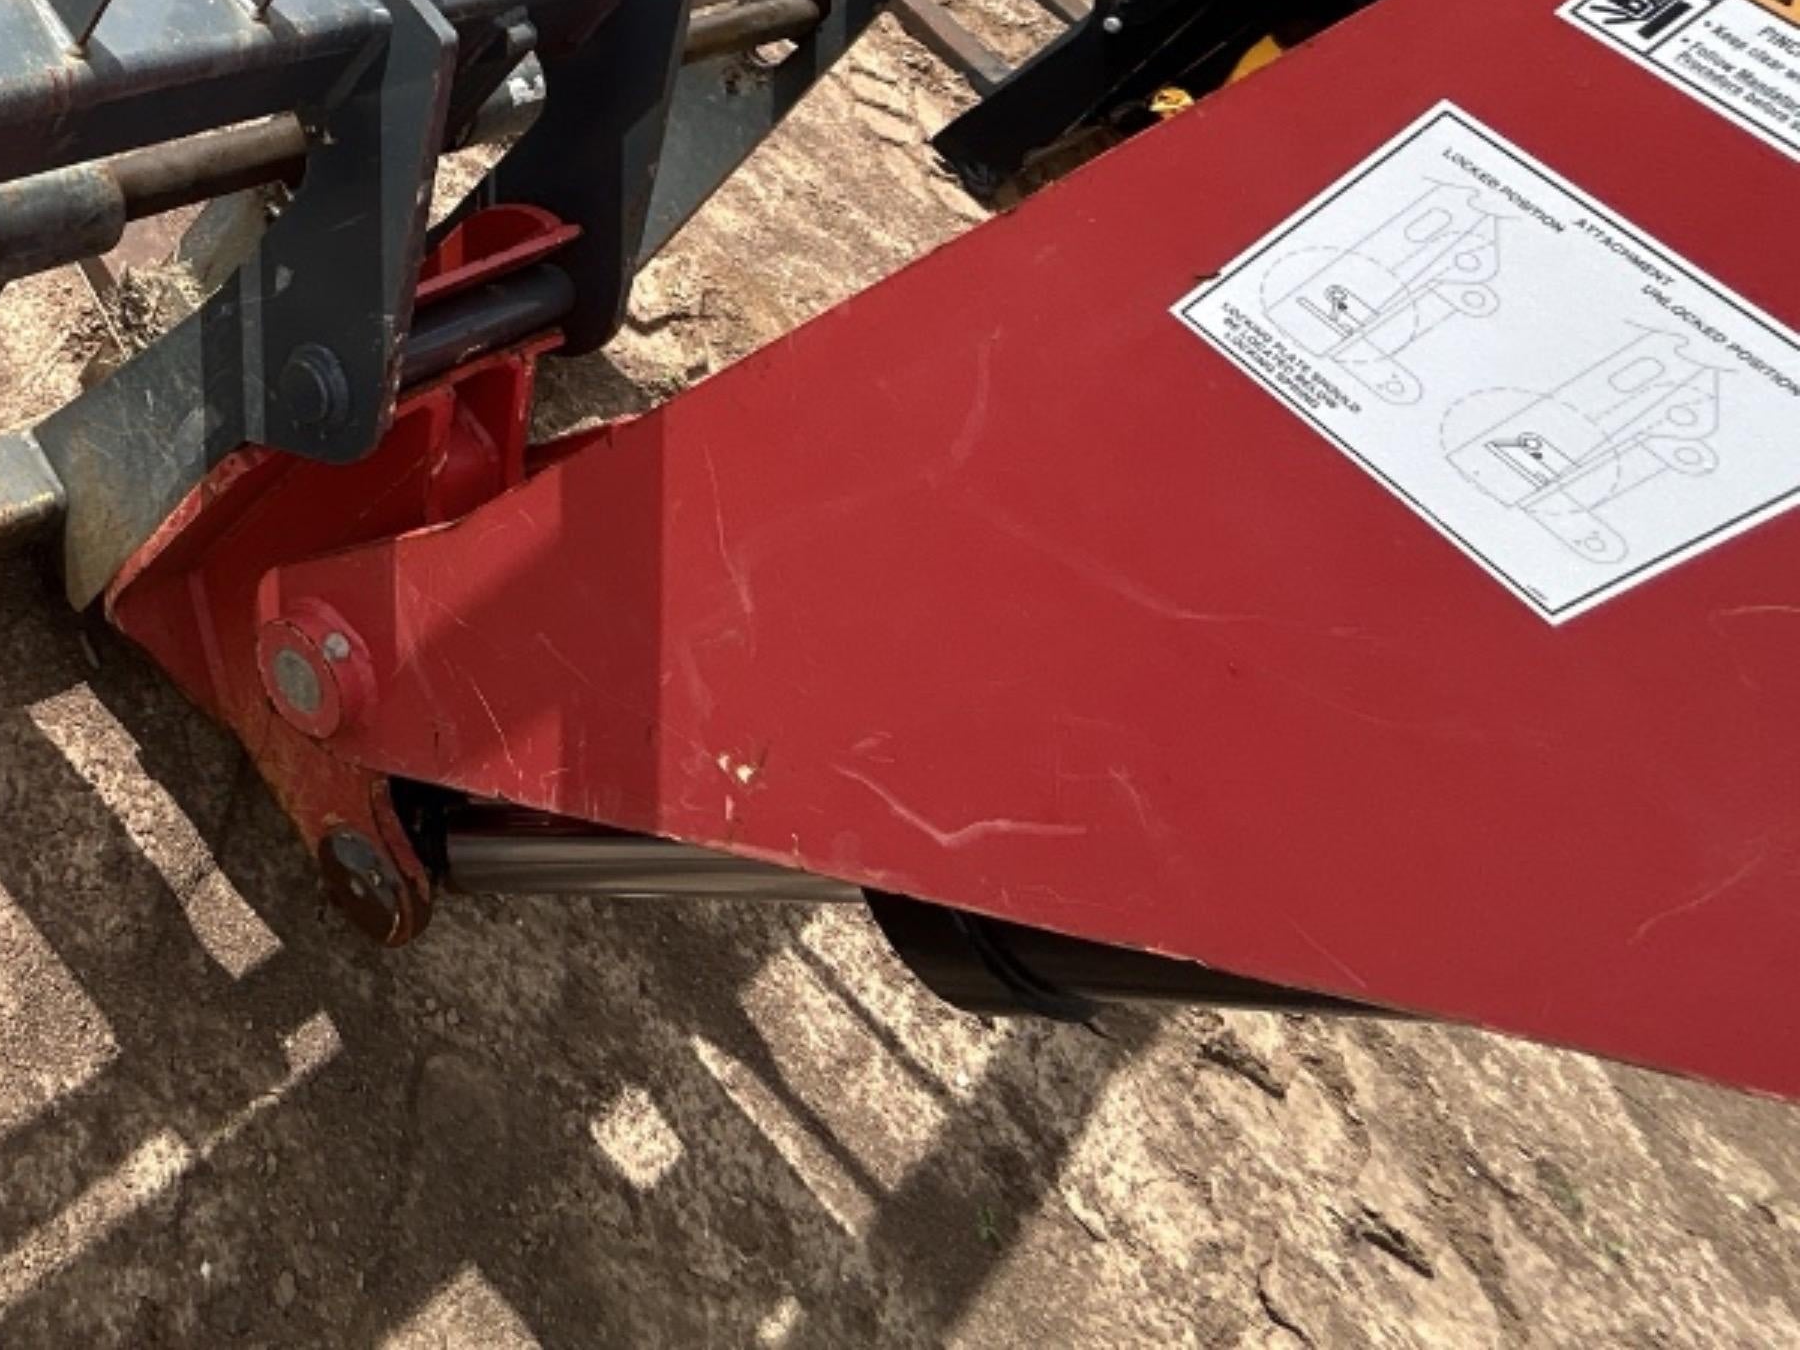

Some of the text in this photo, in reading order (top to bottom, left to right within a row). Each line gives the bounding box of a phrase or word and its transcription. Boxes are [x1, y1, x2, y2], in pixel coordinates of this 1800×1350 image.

[1499, 184, 1566, 234] POSITION
[1571, 217, 1675, 287] ATTACHMENT
[1641, 283, 1728, 344] UNLOCKED
